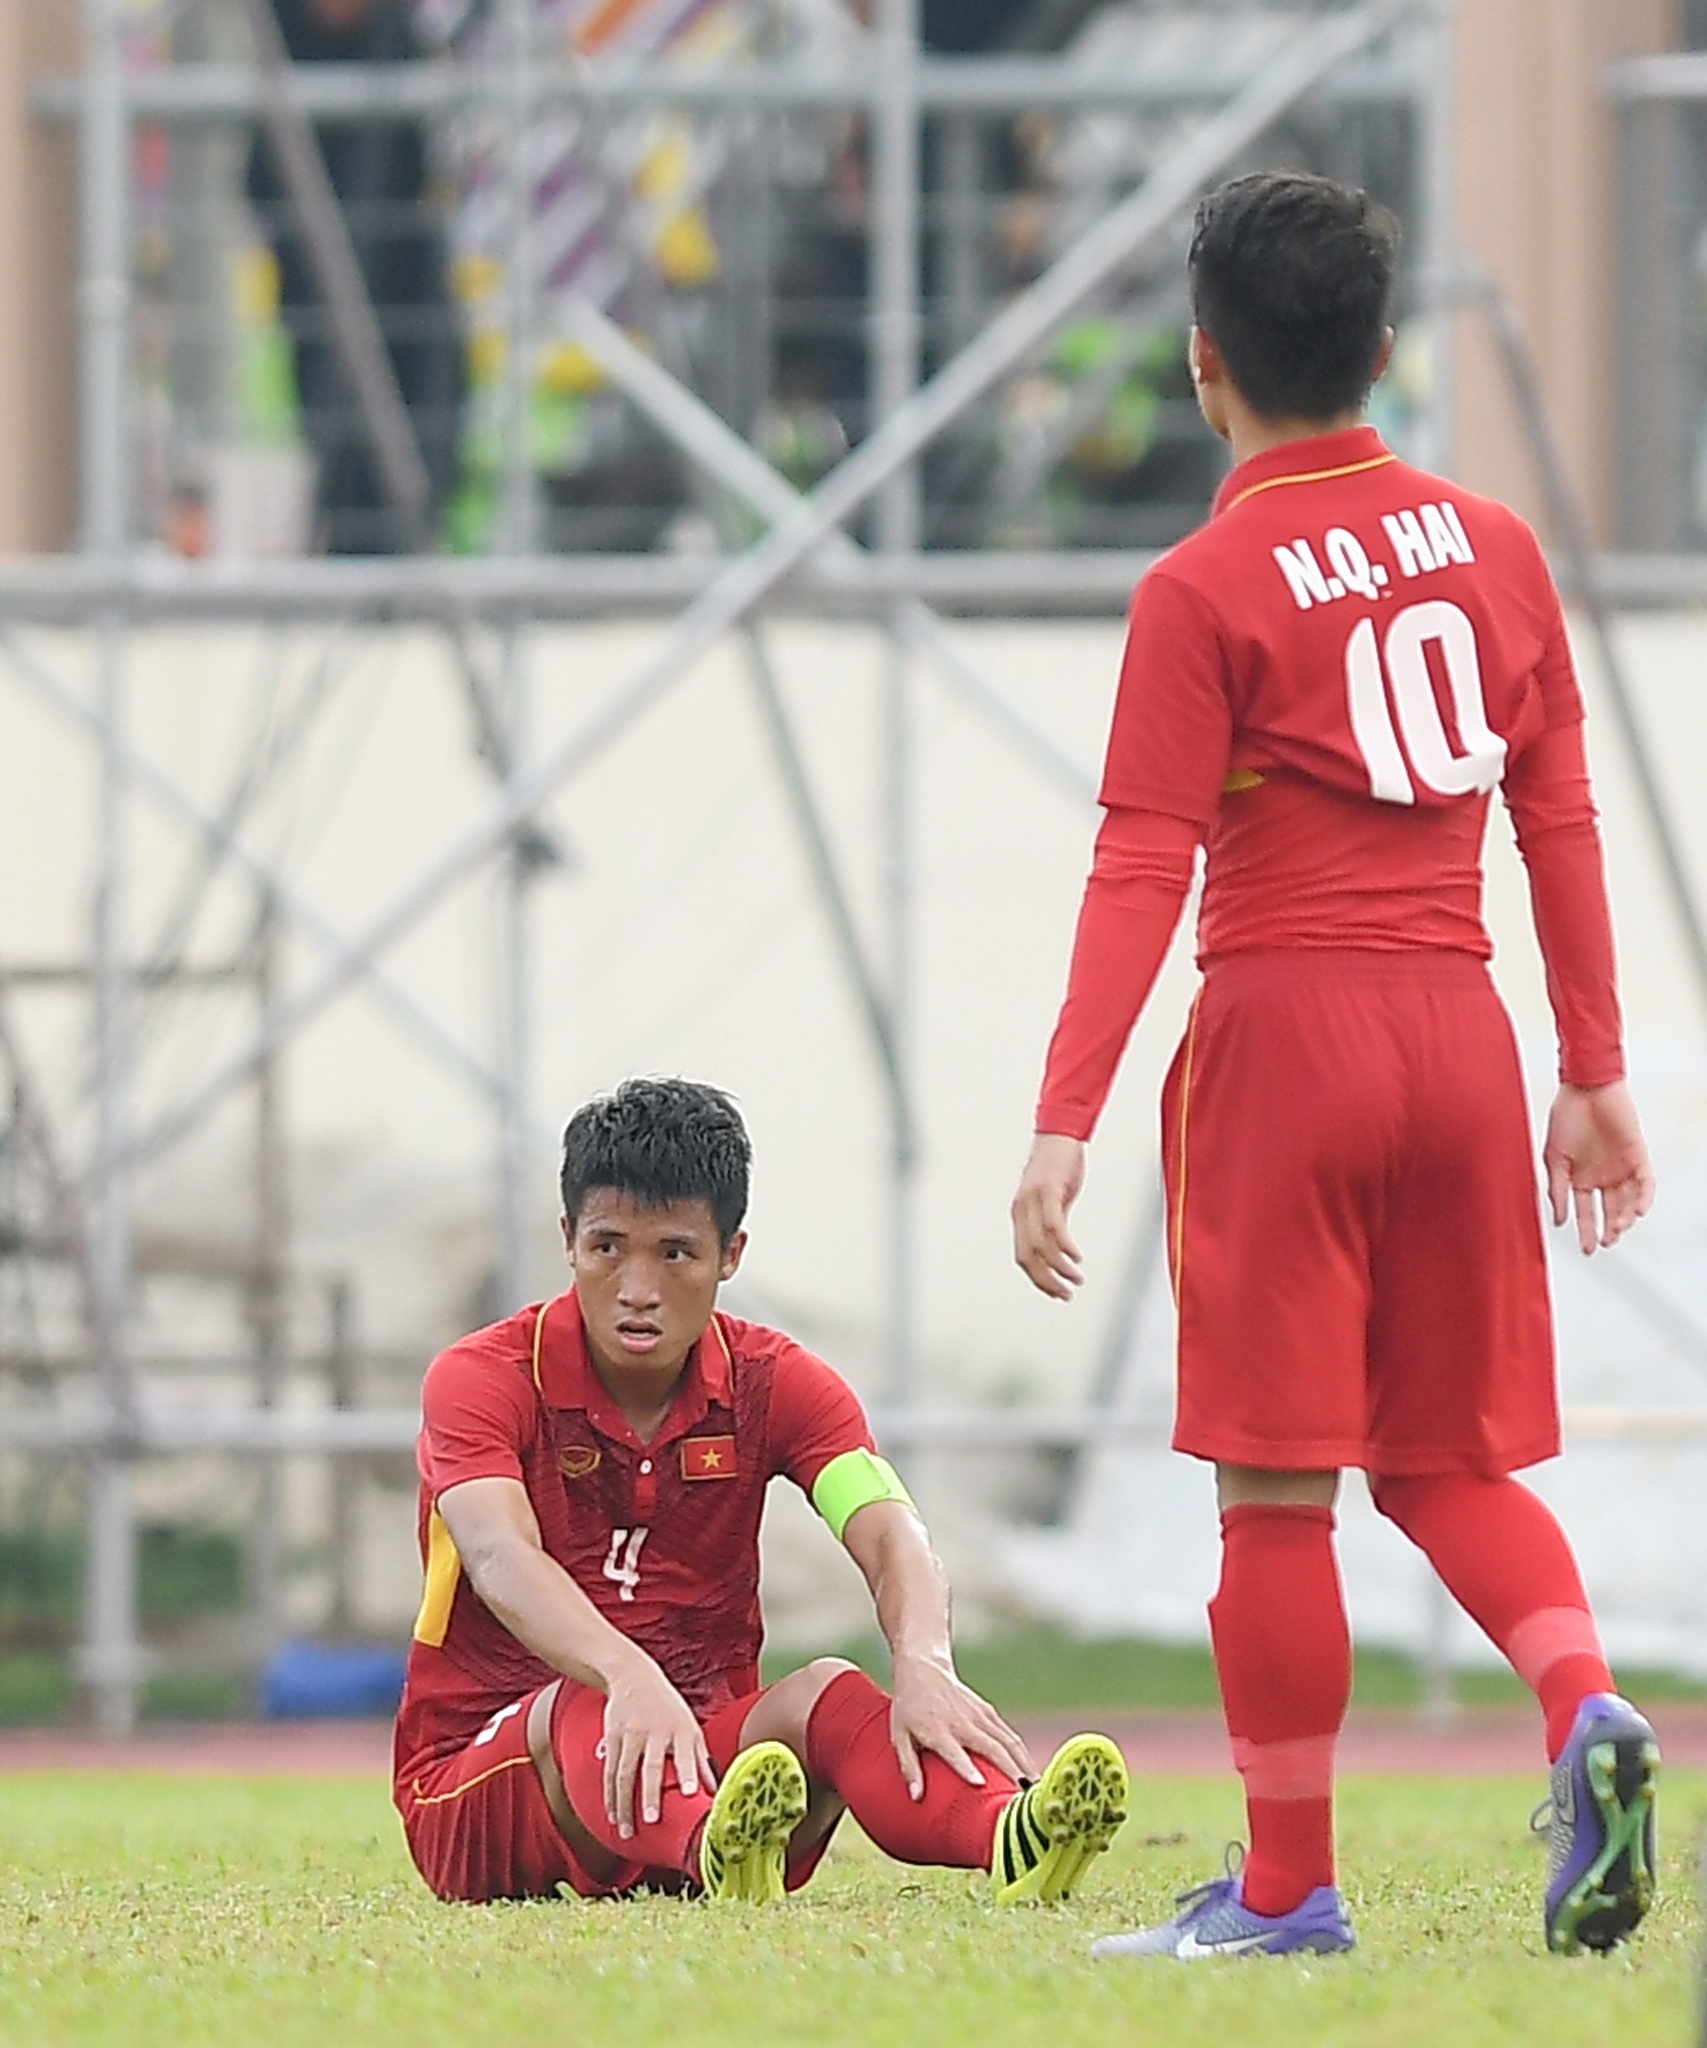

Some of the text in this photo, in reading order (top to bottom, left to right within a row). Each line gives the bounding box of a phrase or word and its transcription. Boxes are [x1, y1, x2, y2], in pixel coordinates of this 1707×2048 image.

[1272, 501, 1476, 610] N.Q. HAI
[1345, 600, 1508, 805] 10
[603, 1527, 649, 1601] 4
